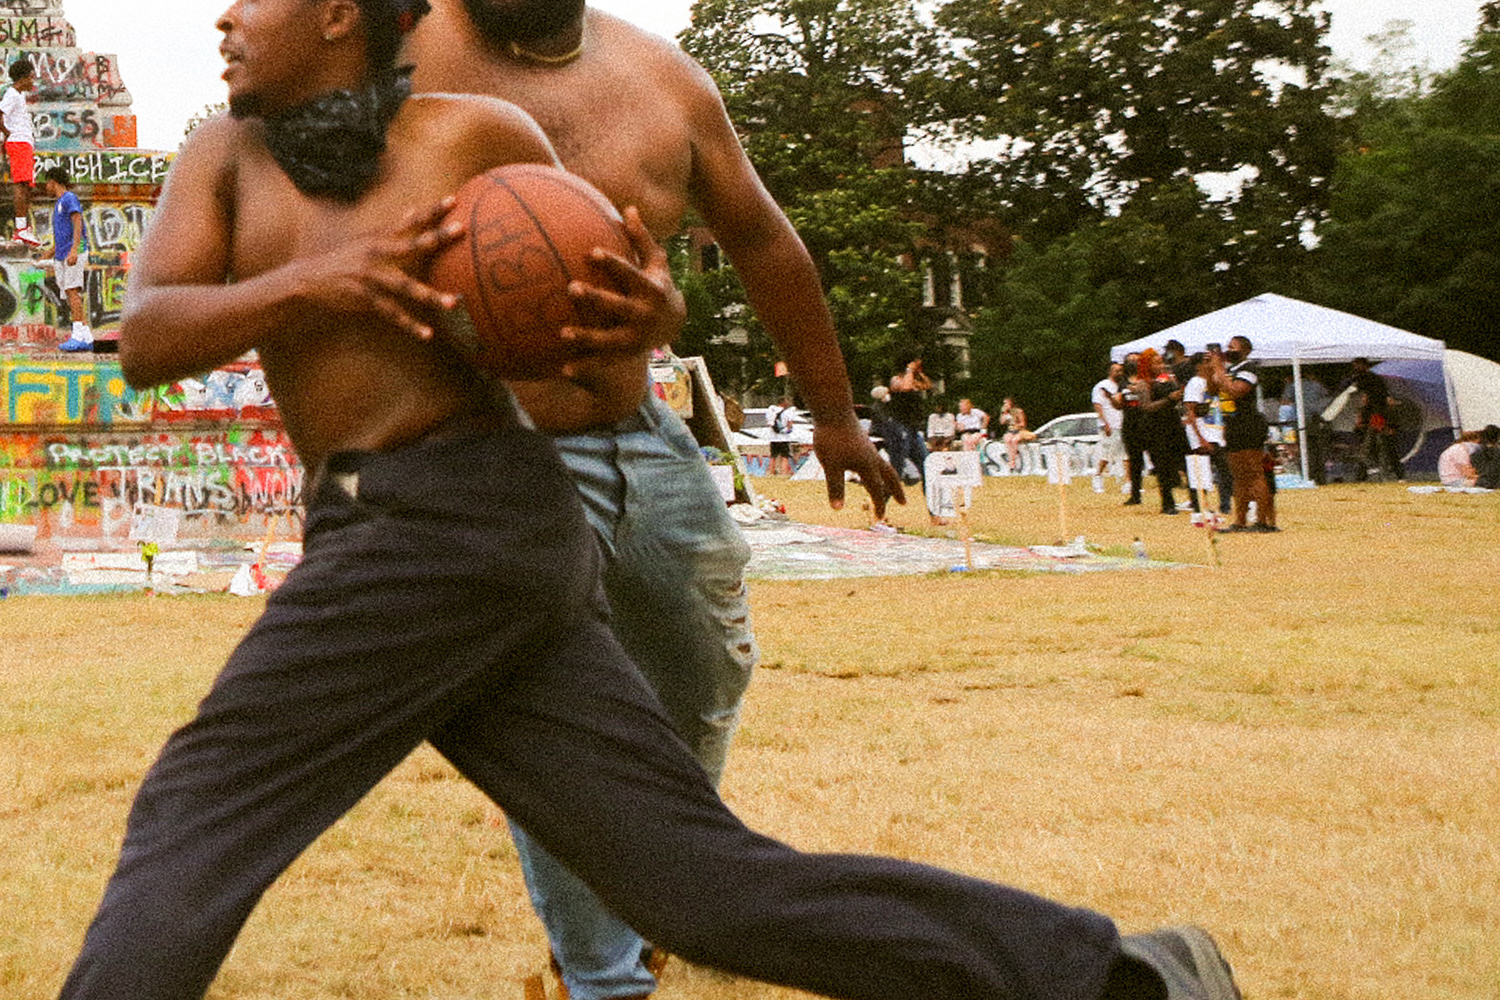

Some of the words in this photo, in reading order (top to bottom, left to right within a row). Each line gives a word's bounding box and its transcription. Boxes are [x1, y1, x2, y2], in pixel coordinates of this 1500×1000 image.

[48, 443, 184, 465] PROTECT
[197, 442, 292, 467] BLACK
[96, 465, 238, 505] TRANS
